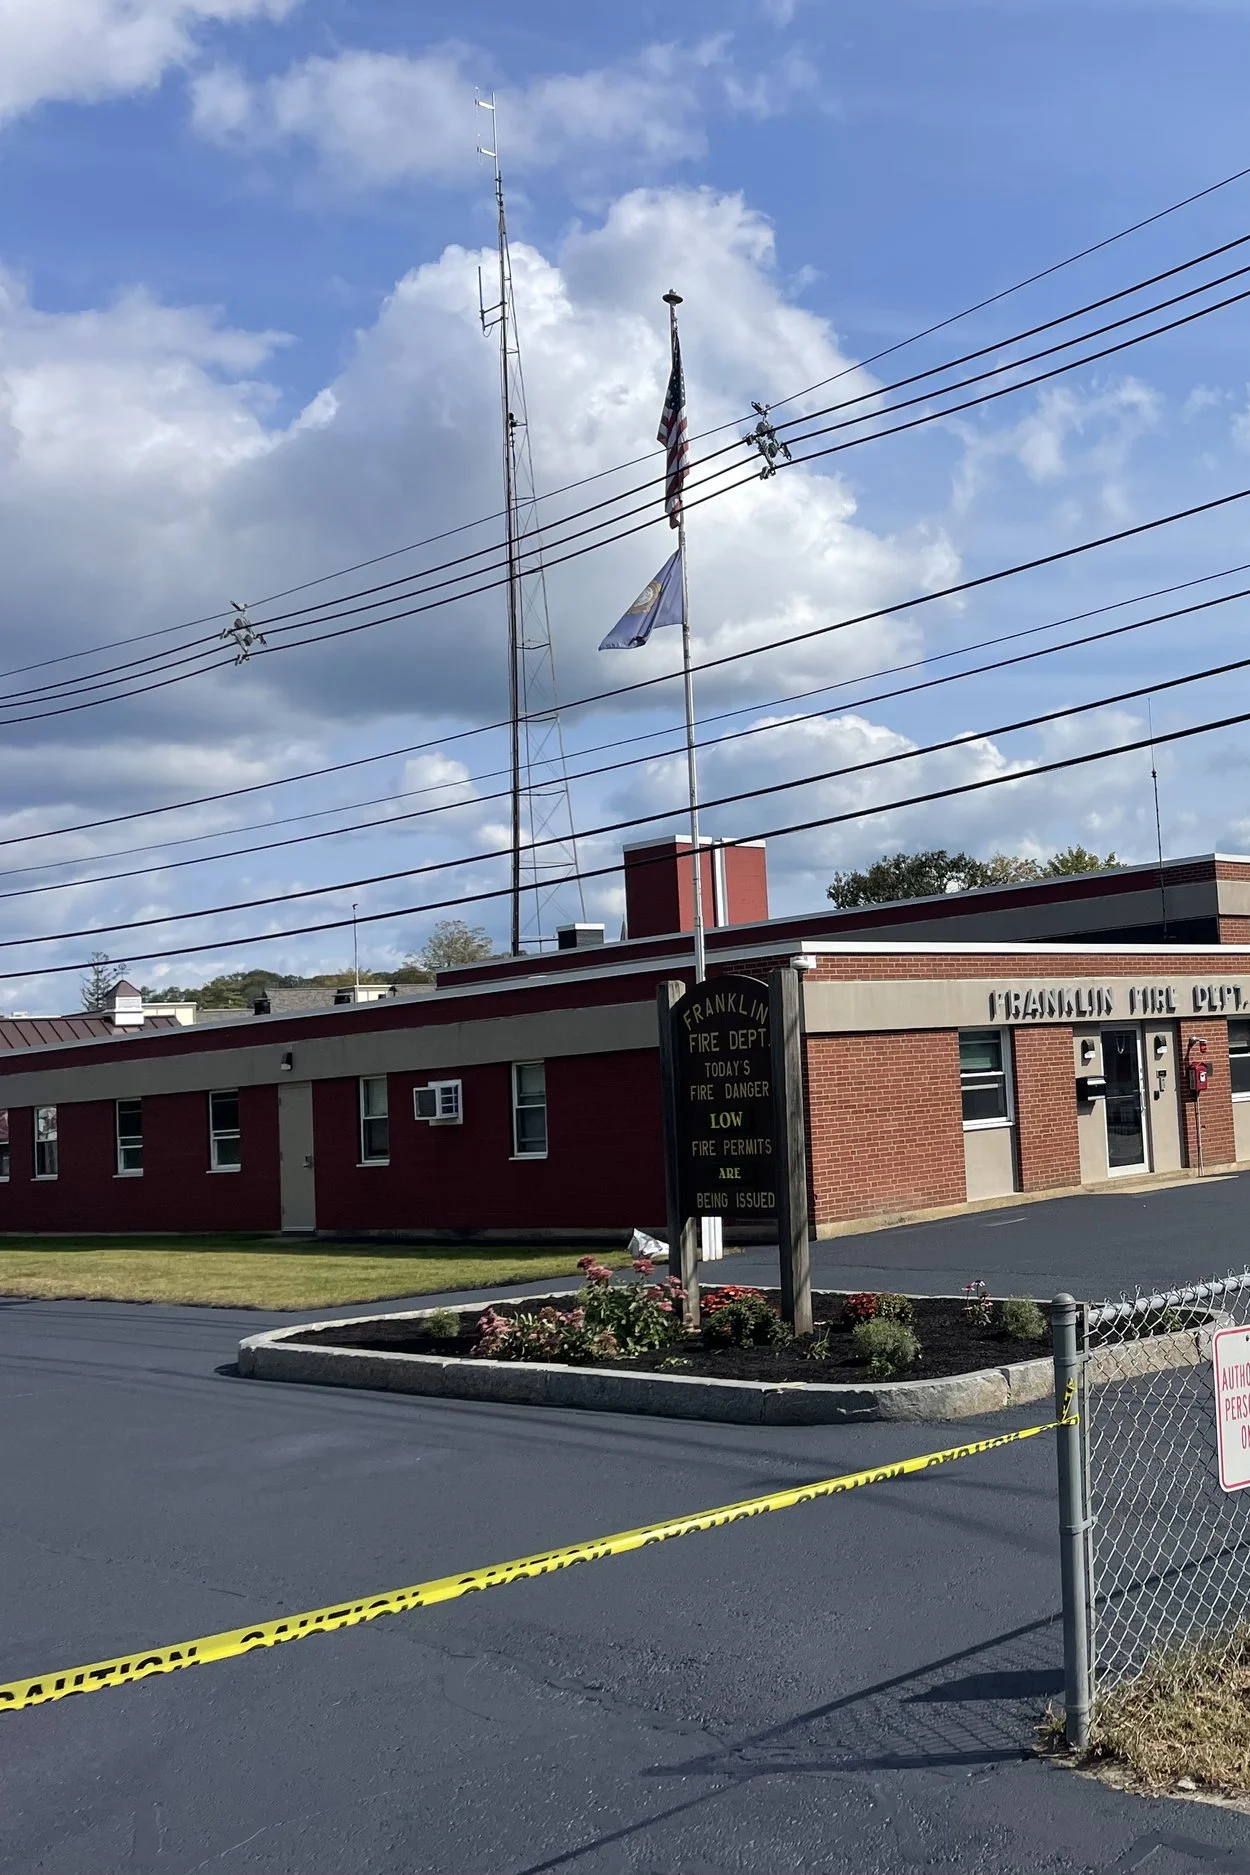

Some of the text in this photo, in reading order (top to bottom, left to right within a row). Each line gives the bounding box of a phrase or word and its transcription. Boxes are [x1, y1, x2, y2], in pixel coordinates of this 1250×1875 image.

[683, 992, 769, 1031] FRANKLIN
[989, 985, 1113, 1021] FRANKLIN
[1129, 985, 1179, 1014] FIRE
[689, 1028, 771, 1053] FIRE DEPT.
[705, 1060, 751, 1078] TODAY'S
[690, 1081, 769, 1101] FIRE DANGER
[710, 1111, 743, 1128] LOW
[692, 1139, 772, 1156] FIRE PERMITS
[719, 1167, 741, 1179] ARE
[697, 1192, 775, 1208] BEING ISSUED
